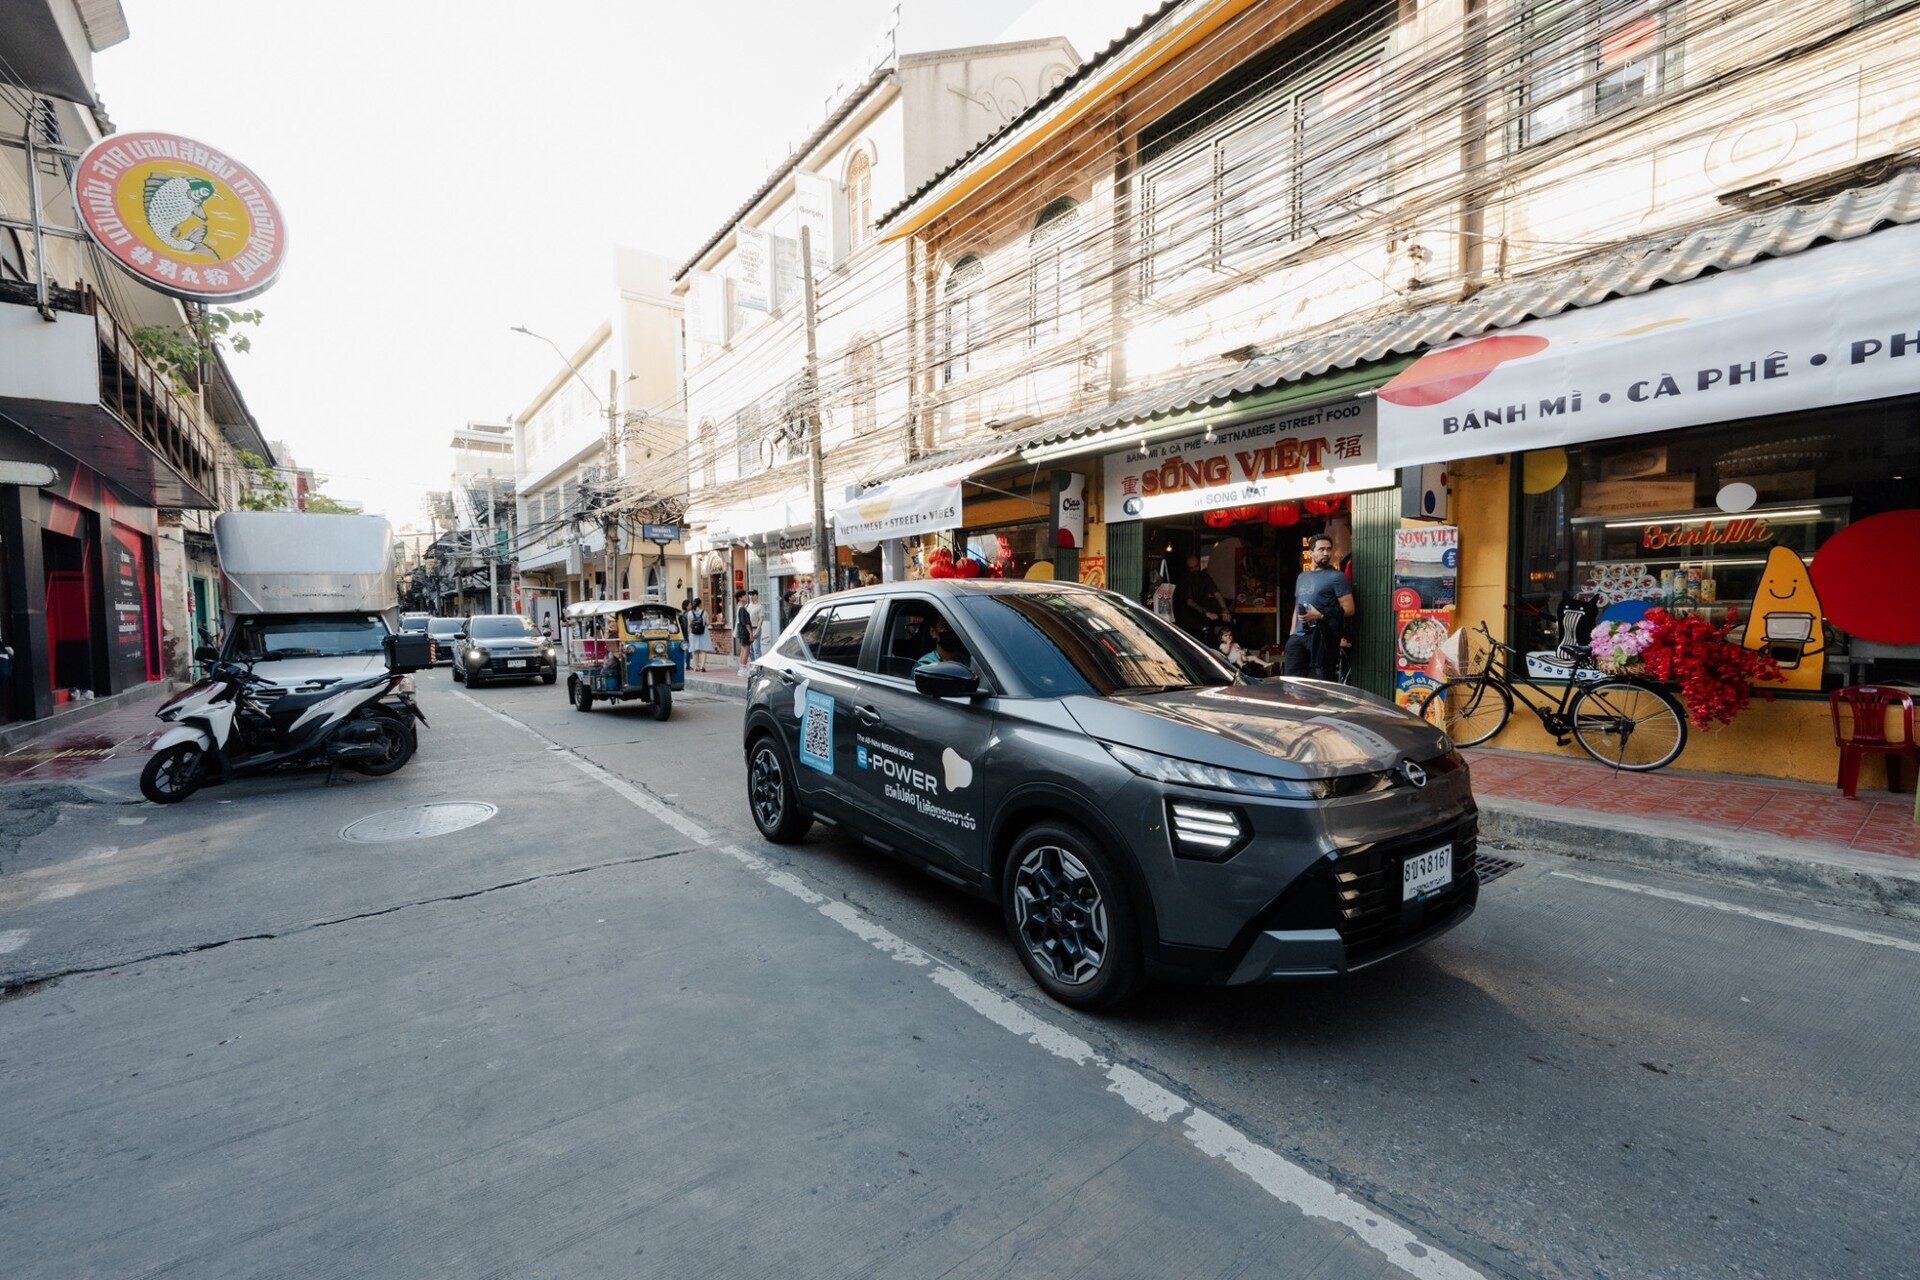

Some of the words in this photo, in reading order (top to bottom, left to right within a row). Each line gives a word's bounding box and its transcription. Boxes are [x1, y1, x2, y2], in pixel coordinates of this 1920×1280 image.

[1442, 402, 1527, 436] BÁNH
[1539, 389, 1582, 419] MÌ
[1626, 372, 1681, 403] CÀ
[1697, 351, 1790, 392] PHÊ
[1161, 448, 1167, 457] &
[1213, 423, 1276, 446] VIETNAMESE
[1279, 414, 1322, 431] STREET
[1326, 405, 1361, 422] FOOD
[1121, 475, 1139, 497] 重
[1334, 433, 1363, 460] 福
[1206, 491, 1238, 505] SONG
[1242, 486, 1268, 501] WAT
[841, 520, 883, 536] VIETNAMESE
[890, 513, 920, 528] STREET
[929, 506, 955, 521] VIBES
[779, 534, 811, 550] Garçon
[881, 742, 898, 755] NISSAN
[898, 748, 914, 761] KICKS
[857, 749, 938, 796] e-POWER
